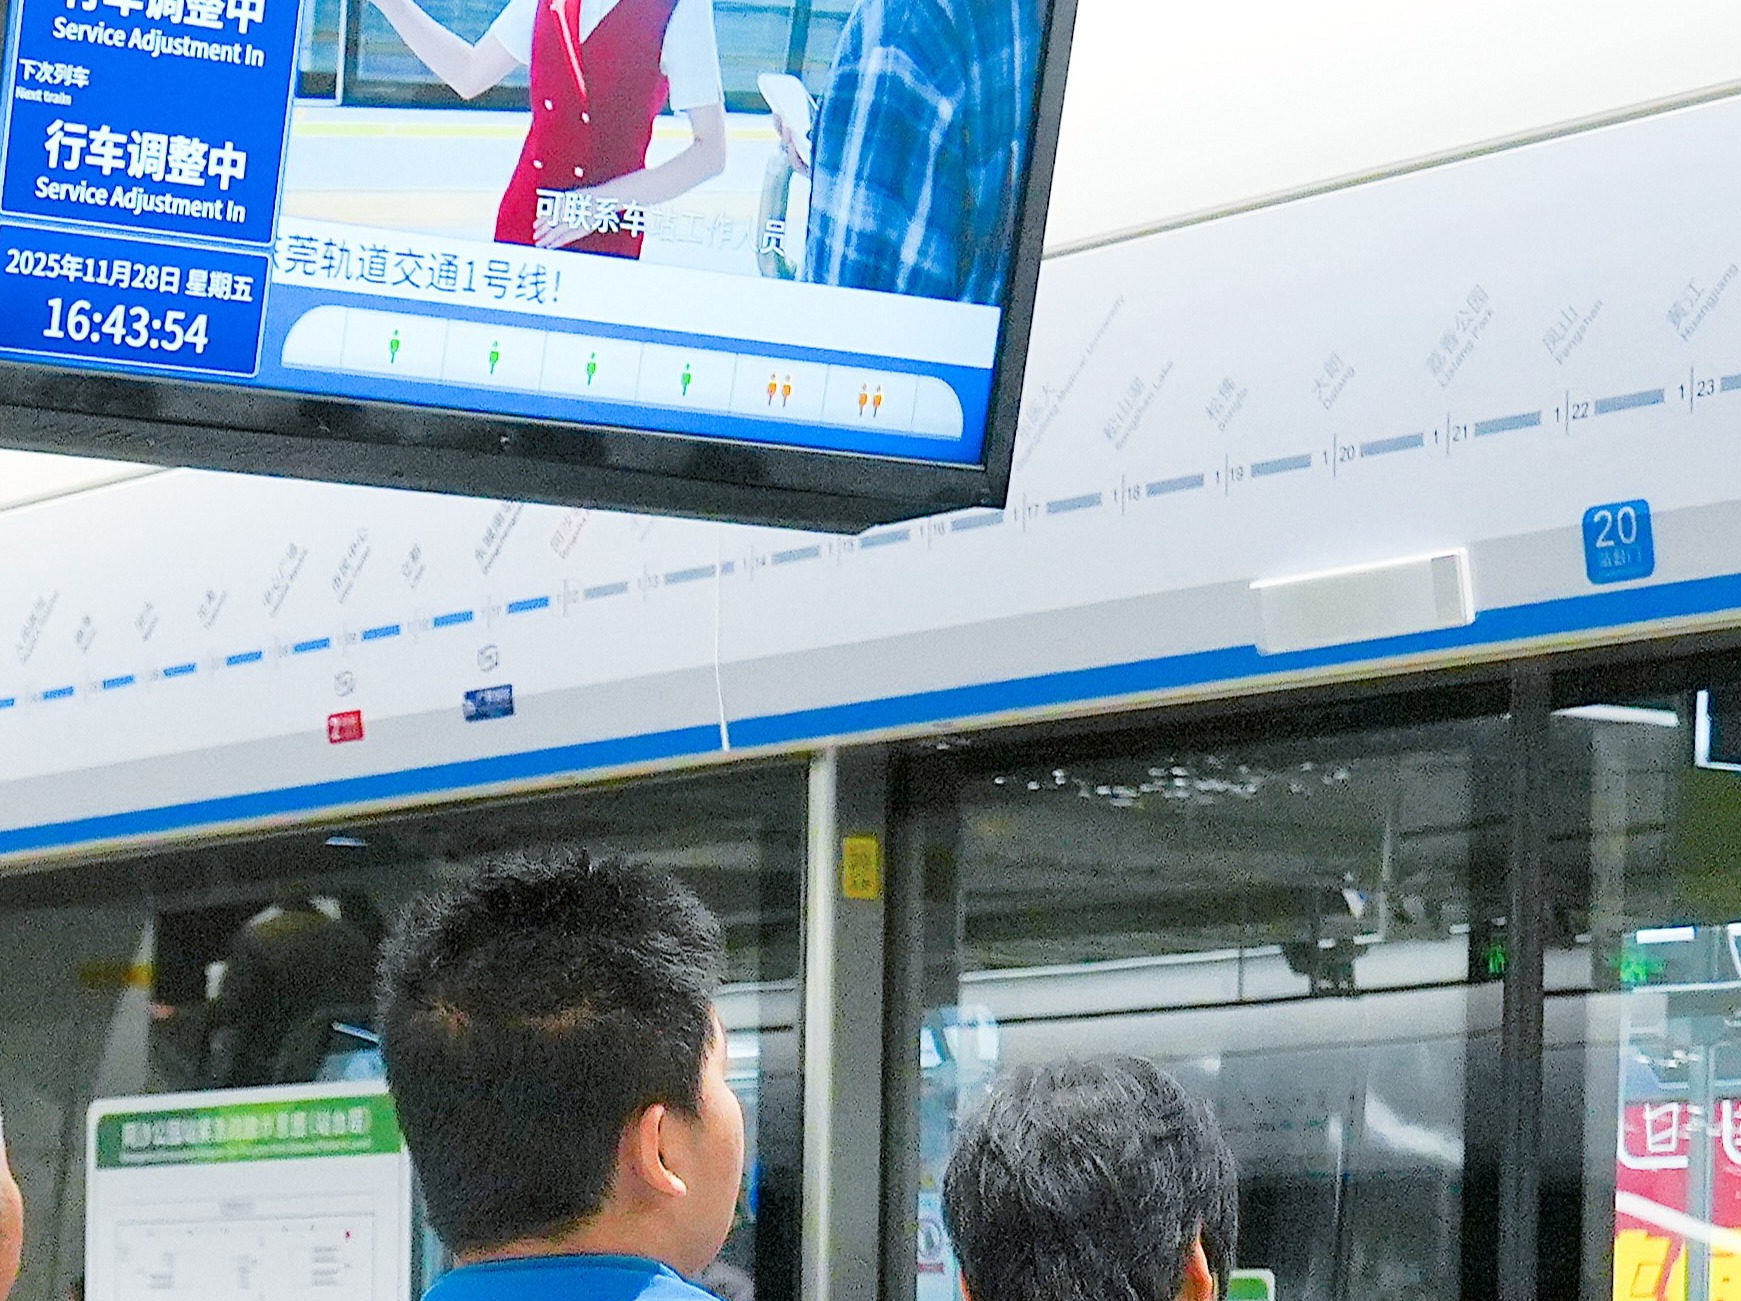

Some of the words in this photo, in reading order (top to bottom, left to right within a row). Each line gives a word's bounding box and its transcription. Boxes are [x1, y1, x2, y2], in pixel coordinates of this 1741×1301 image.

[53, 17, 125, 49] Service
[128, 27, 242, 66] Adjustment
[245, 43, 266, 68] In
[19, 58, 91, 89] 下次列车
[45, 119, 247, 191] 行车调整中
[35, 176, 107, 207] Service
[110, 185, 223, 222] Adjustment
[226, 200, 247, 224] In
[5, 247, 182, 292] 2025年11月28日
[184, 268, 254, 304] 星期五
[42, 296, 210, 355] 16:43:54
[1696, 378, 1716, 398] 23
[1451, 424, 1468, 442] 21
[1571, 402, 1590, 421] 22
[1339, 445, 1356, 463] 20
[1592, 505, 1638, 549] 20
